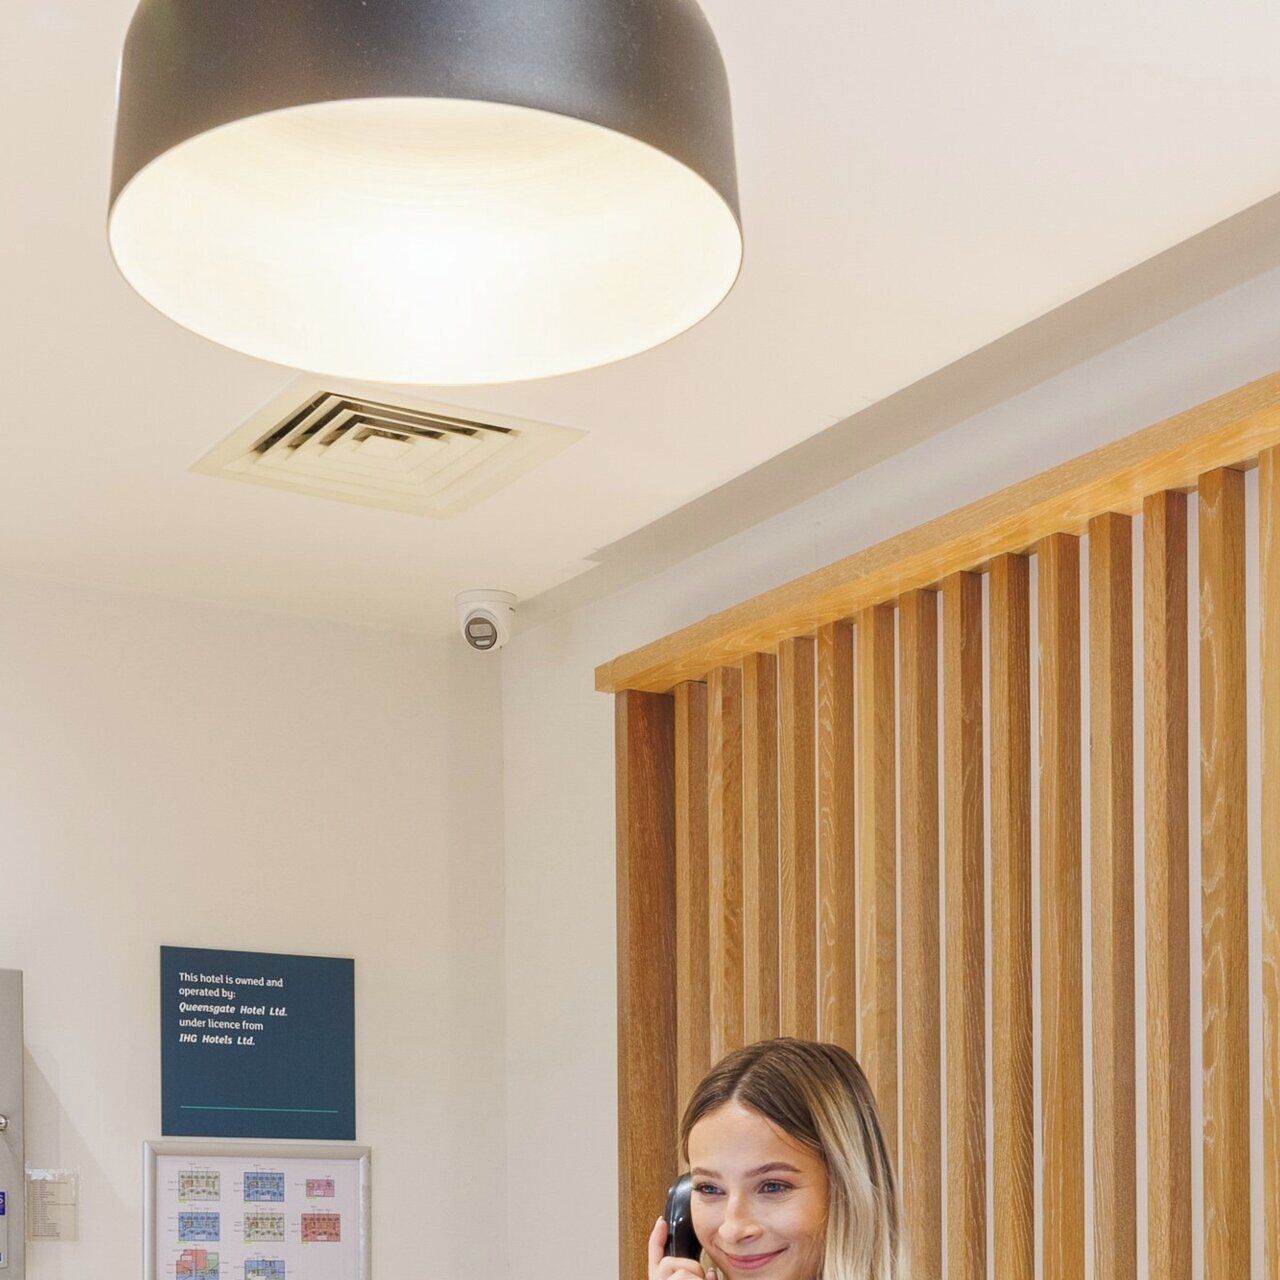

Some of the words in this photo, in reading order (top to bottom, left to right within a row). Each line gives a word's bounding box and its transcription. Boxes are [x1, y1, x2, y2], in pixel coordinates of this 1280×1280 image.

[179, 972, 198, 983] This
[200, 973, 223, 984] hotel
[225, 974, 234, 985] is
[235, 976, 264, 986] owned
[266, 978, 283, 987] and
[179, 987, 220, 997] operated
[221, 988, 236, 1000] by:
[179, 1002, 236, 1015] Queensgate
[240, 1005, 265, 1015] Hotel
[269, 1007, 288, 1017] Ltd.
[179, 1018, 206, 1028] under
[208, 1018, 240, 1029] licence
[242, 1020, 264, 1030] from
[179, 1033, 198, 1043] IHG
[202, 1034, 232, 1045] Hotels
[237, 1036, 255, 1046] Ltd.
